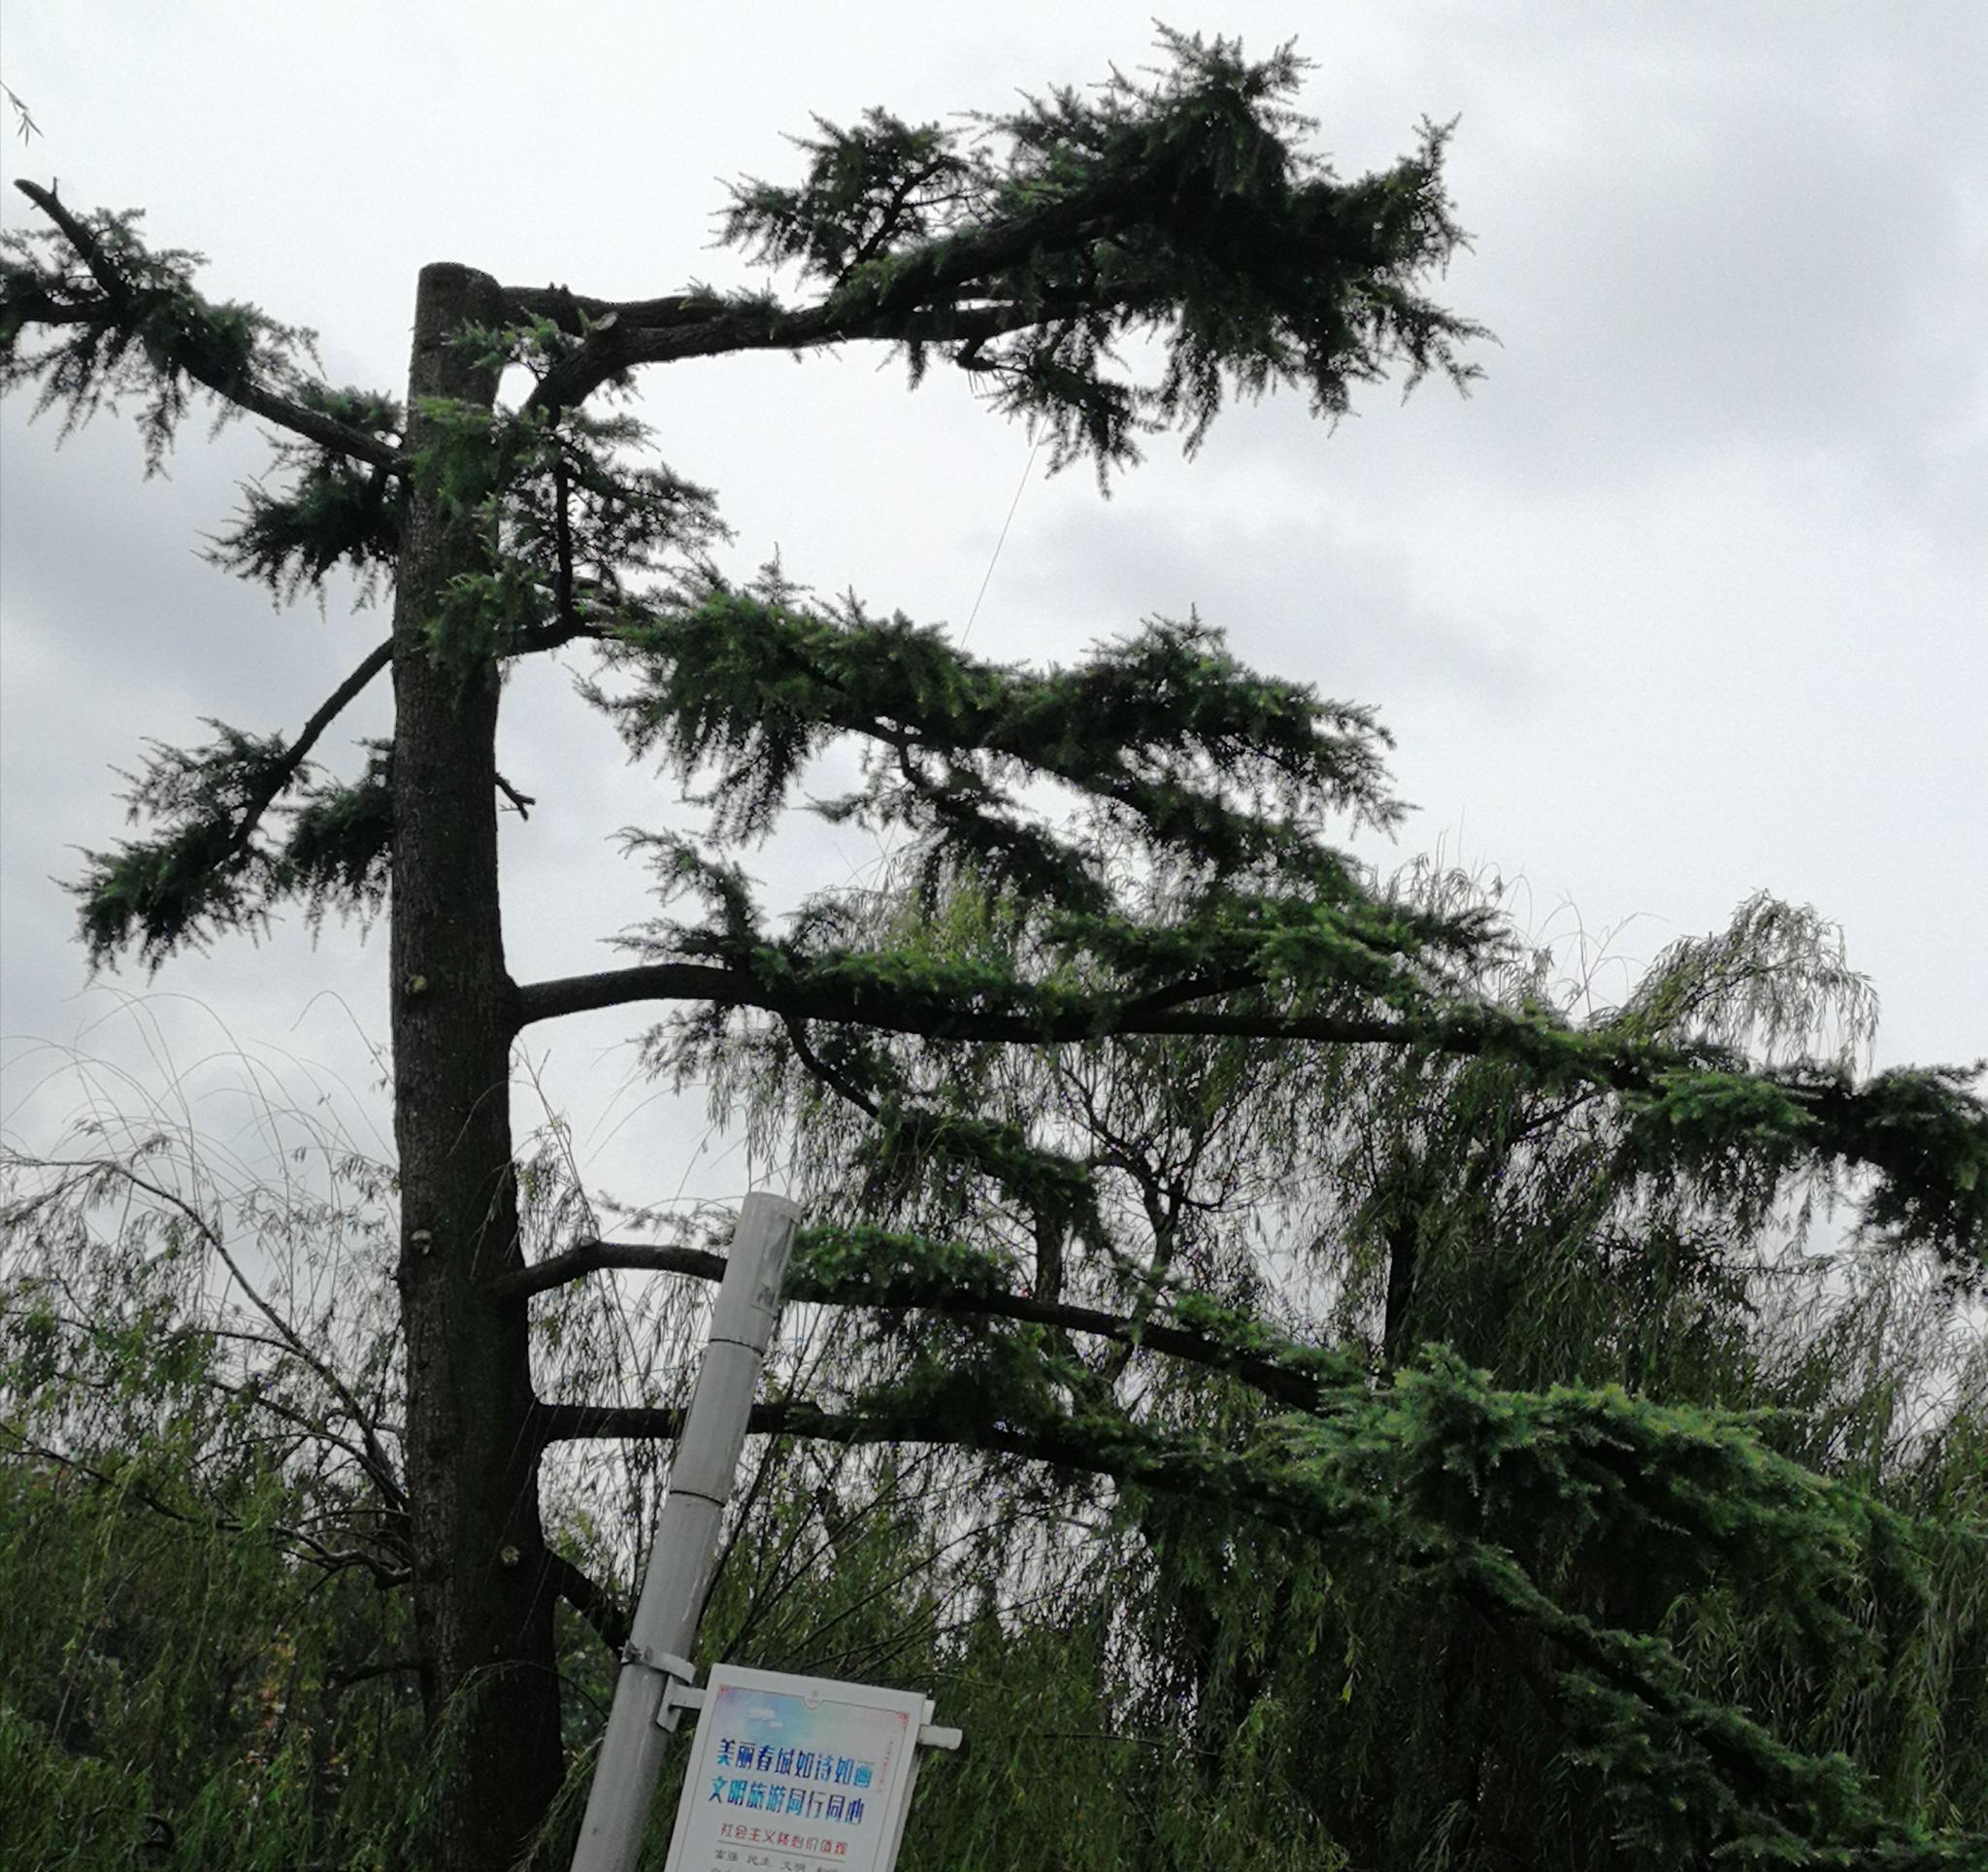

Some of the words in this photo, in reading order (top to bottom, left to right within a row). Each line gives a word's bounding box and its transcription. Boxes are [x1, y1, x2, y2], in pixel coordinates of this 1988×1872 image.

[716, 1738, 876, 1788] 美丽春城如诗如画
[708, 1776, 865, 1825] 文明旅游同行同心
